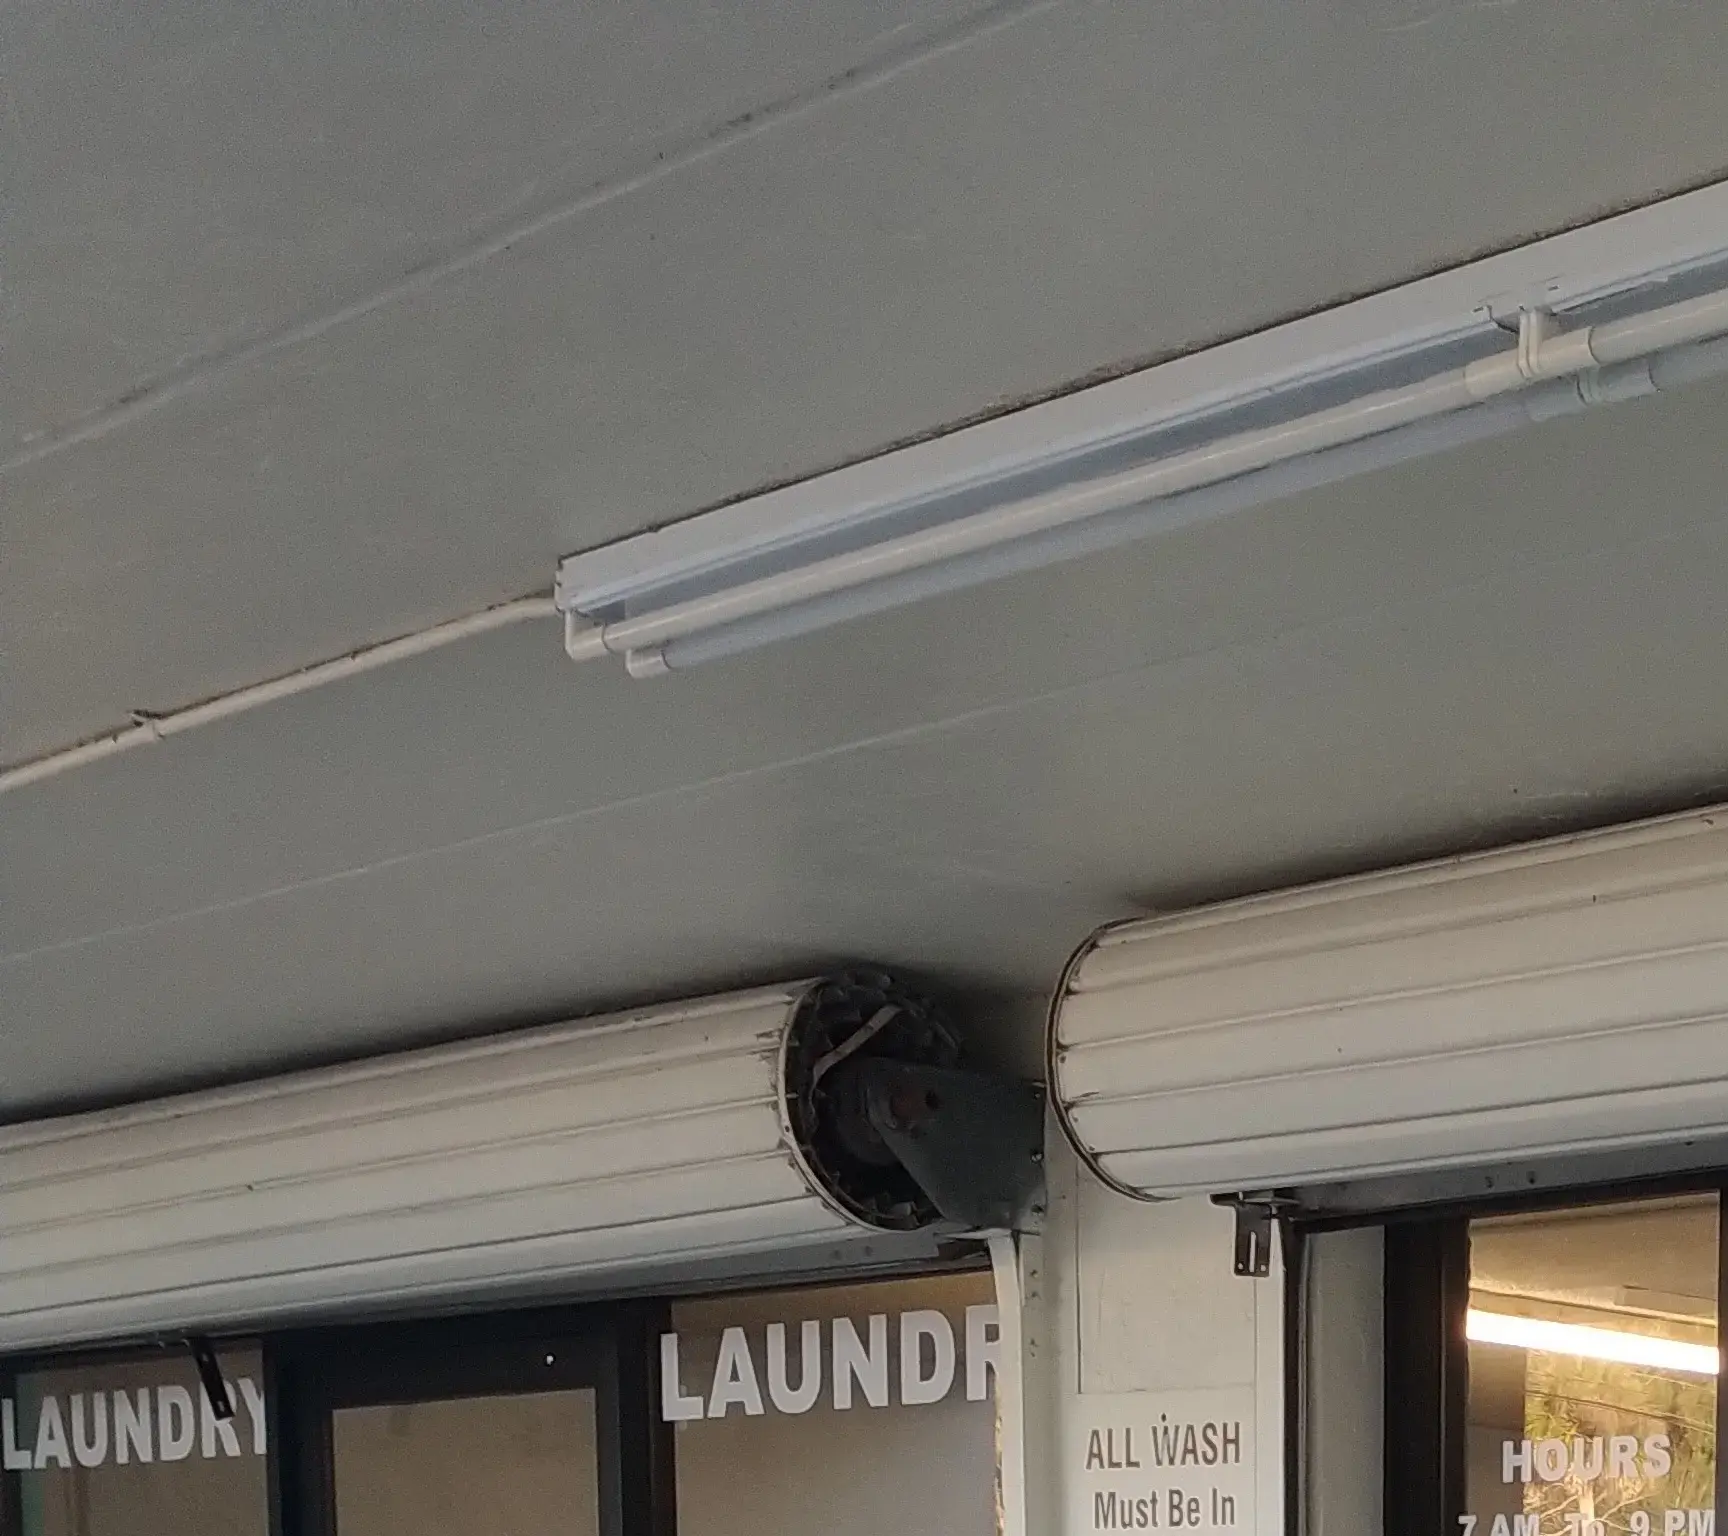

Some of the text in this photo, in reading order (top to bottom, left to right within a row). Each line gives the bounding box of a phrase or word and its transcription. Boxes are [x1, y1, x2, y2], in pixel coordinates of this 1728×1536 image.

[1, 1377, 267, 1470] LAUNDRY
[1085, 1421, 1241, 1470] ALL WASH
[1502, 1434, 1672, 1483] HOURS
[1094, 1487, 1235, 1530] Must Be In
